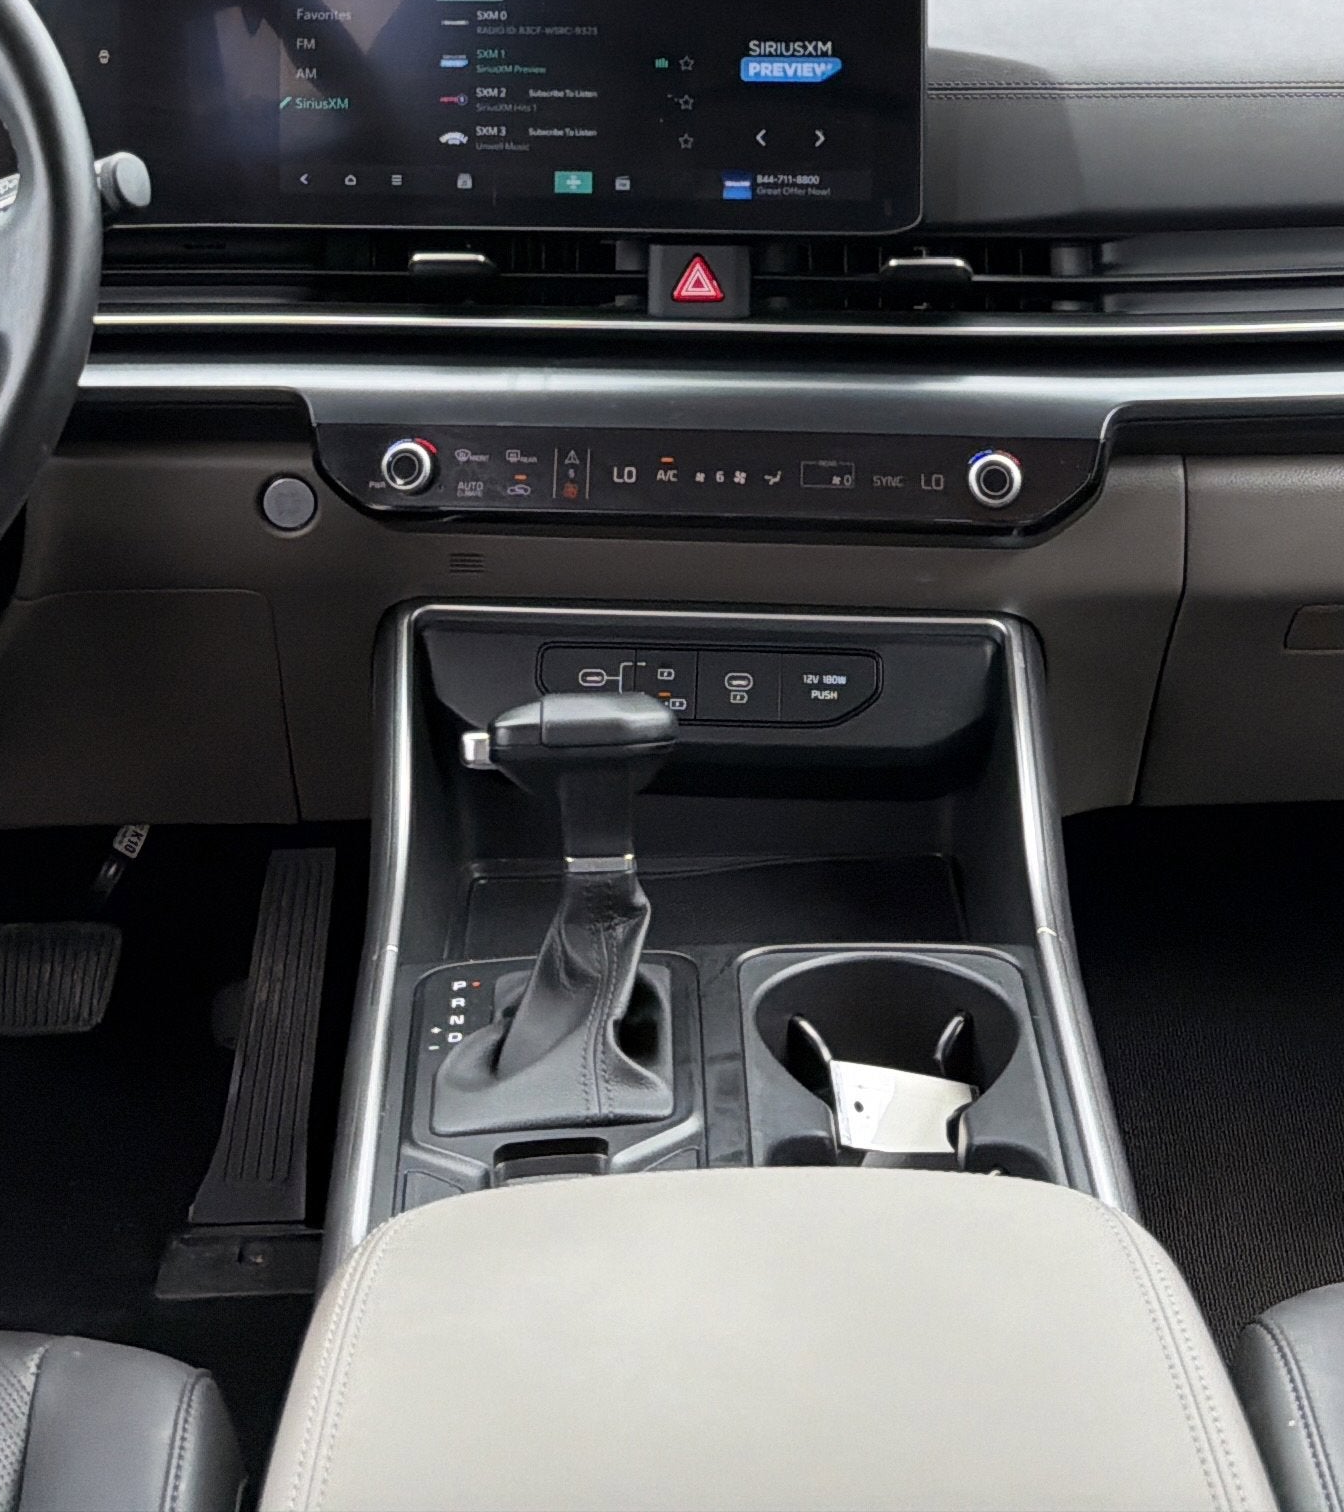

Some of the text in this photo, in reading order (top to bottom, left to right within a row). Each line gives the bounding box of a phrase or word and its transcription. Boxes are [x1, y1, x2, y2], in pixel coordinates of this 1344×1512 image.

[296, 8, 352, 21] Favorites
[476, 10, 507, 21] SXM 0
[296, 39, 316, 50] FM
[749, 40, 832, 56] SIRIUSXM
[476, 49, 505, 59] SXM 1
[296, 68, 317, 80] AM
[476, 64, 546, 74] SiriusXM Preview
[749, 62, 833, 77] PREVIEW
[476, 88, 506, 98] SXM 2
[528, 89, 598, 98] Subscribe To Listen
[295, 97, 349, 110] SiriusXM
[476, 103, 512, 112] SiriusXM
[476, 126, 506, 136] SXM 3
[528, 127, 598, 136] Subscribe To Listen
[505, 143, 530, 152] Music
[757, 174, 820, 185] 844-711-8800
[757, 187, 831, 196] Great Offer Now!
[613, 466, 637, 483] LO
[657, 470, 678, 482] A/C
[716, 471, 724, 483] 6
[457, 481, 484, 490] AUTO
[843, 475, 852, 486] 0
[872, 475, 905, 487] SYNC
[921, 474, 944, 490] LO
[803, 674, 847, 685] 12V 180W
[811, 689, 838, 700] PUSH
[452, 980, 467, 992] P
[451, 997, 466, 1008] R
[449, 1014, 465, 1026] N
[447, 1032, 463, 1043] D
